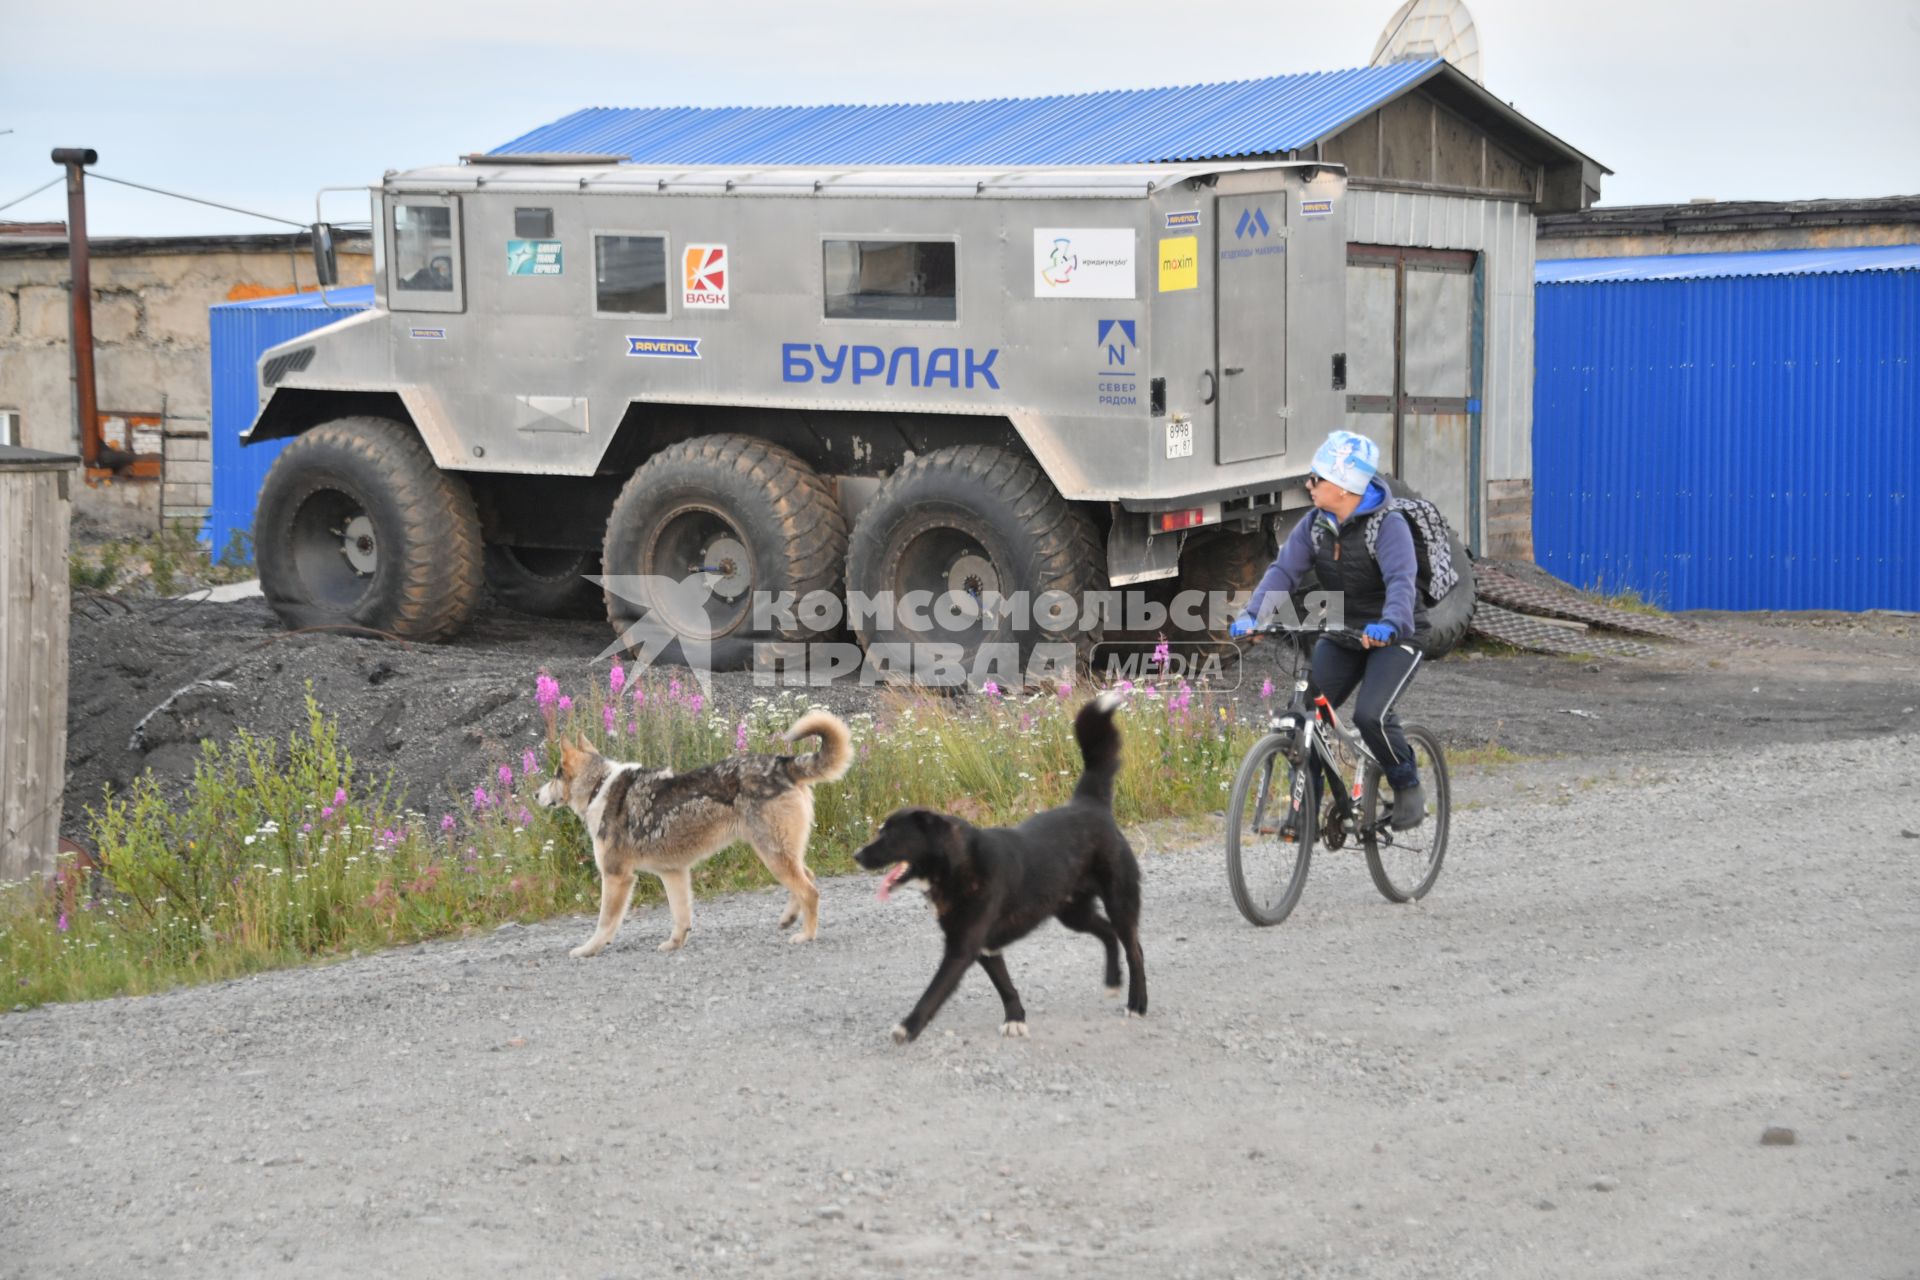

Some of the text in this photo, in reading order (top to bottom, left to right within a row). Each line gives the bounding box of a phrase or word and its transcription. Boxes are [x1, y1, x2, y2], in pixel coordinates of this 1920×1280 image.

[1163, 257, 1193, 271] maxim
[686, 293, 726, 304] BASK
[635, 341, 692, 353] RAVENOL
[1109, 344, 1125, 366] N
[782, 343, 1000, 389] БУРЛАК
[1098, 383, 1136, 392] СЕВЕР
[1099, 396, 1136, 406] РЯДОМ
[1170, 423, 1189, 439] 8998
[1183, 439, 1191, 450] 87
